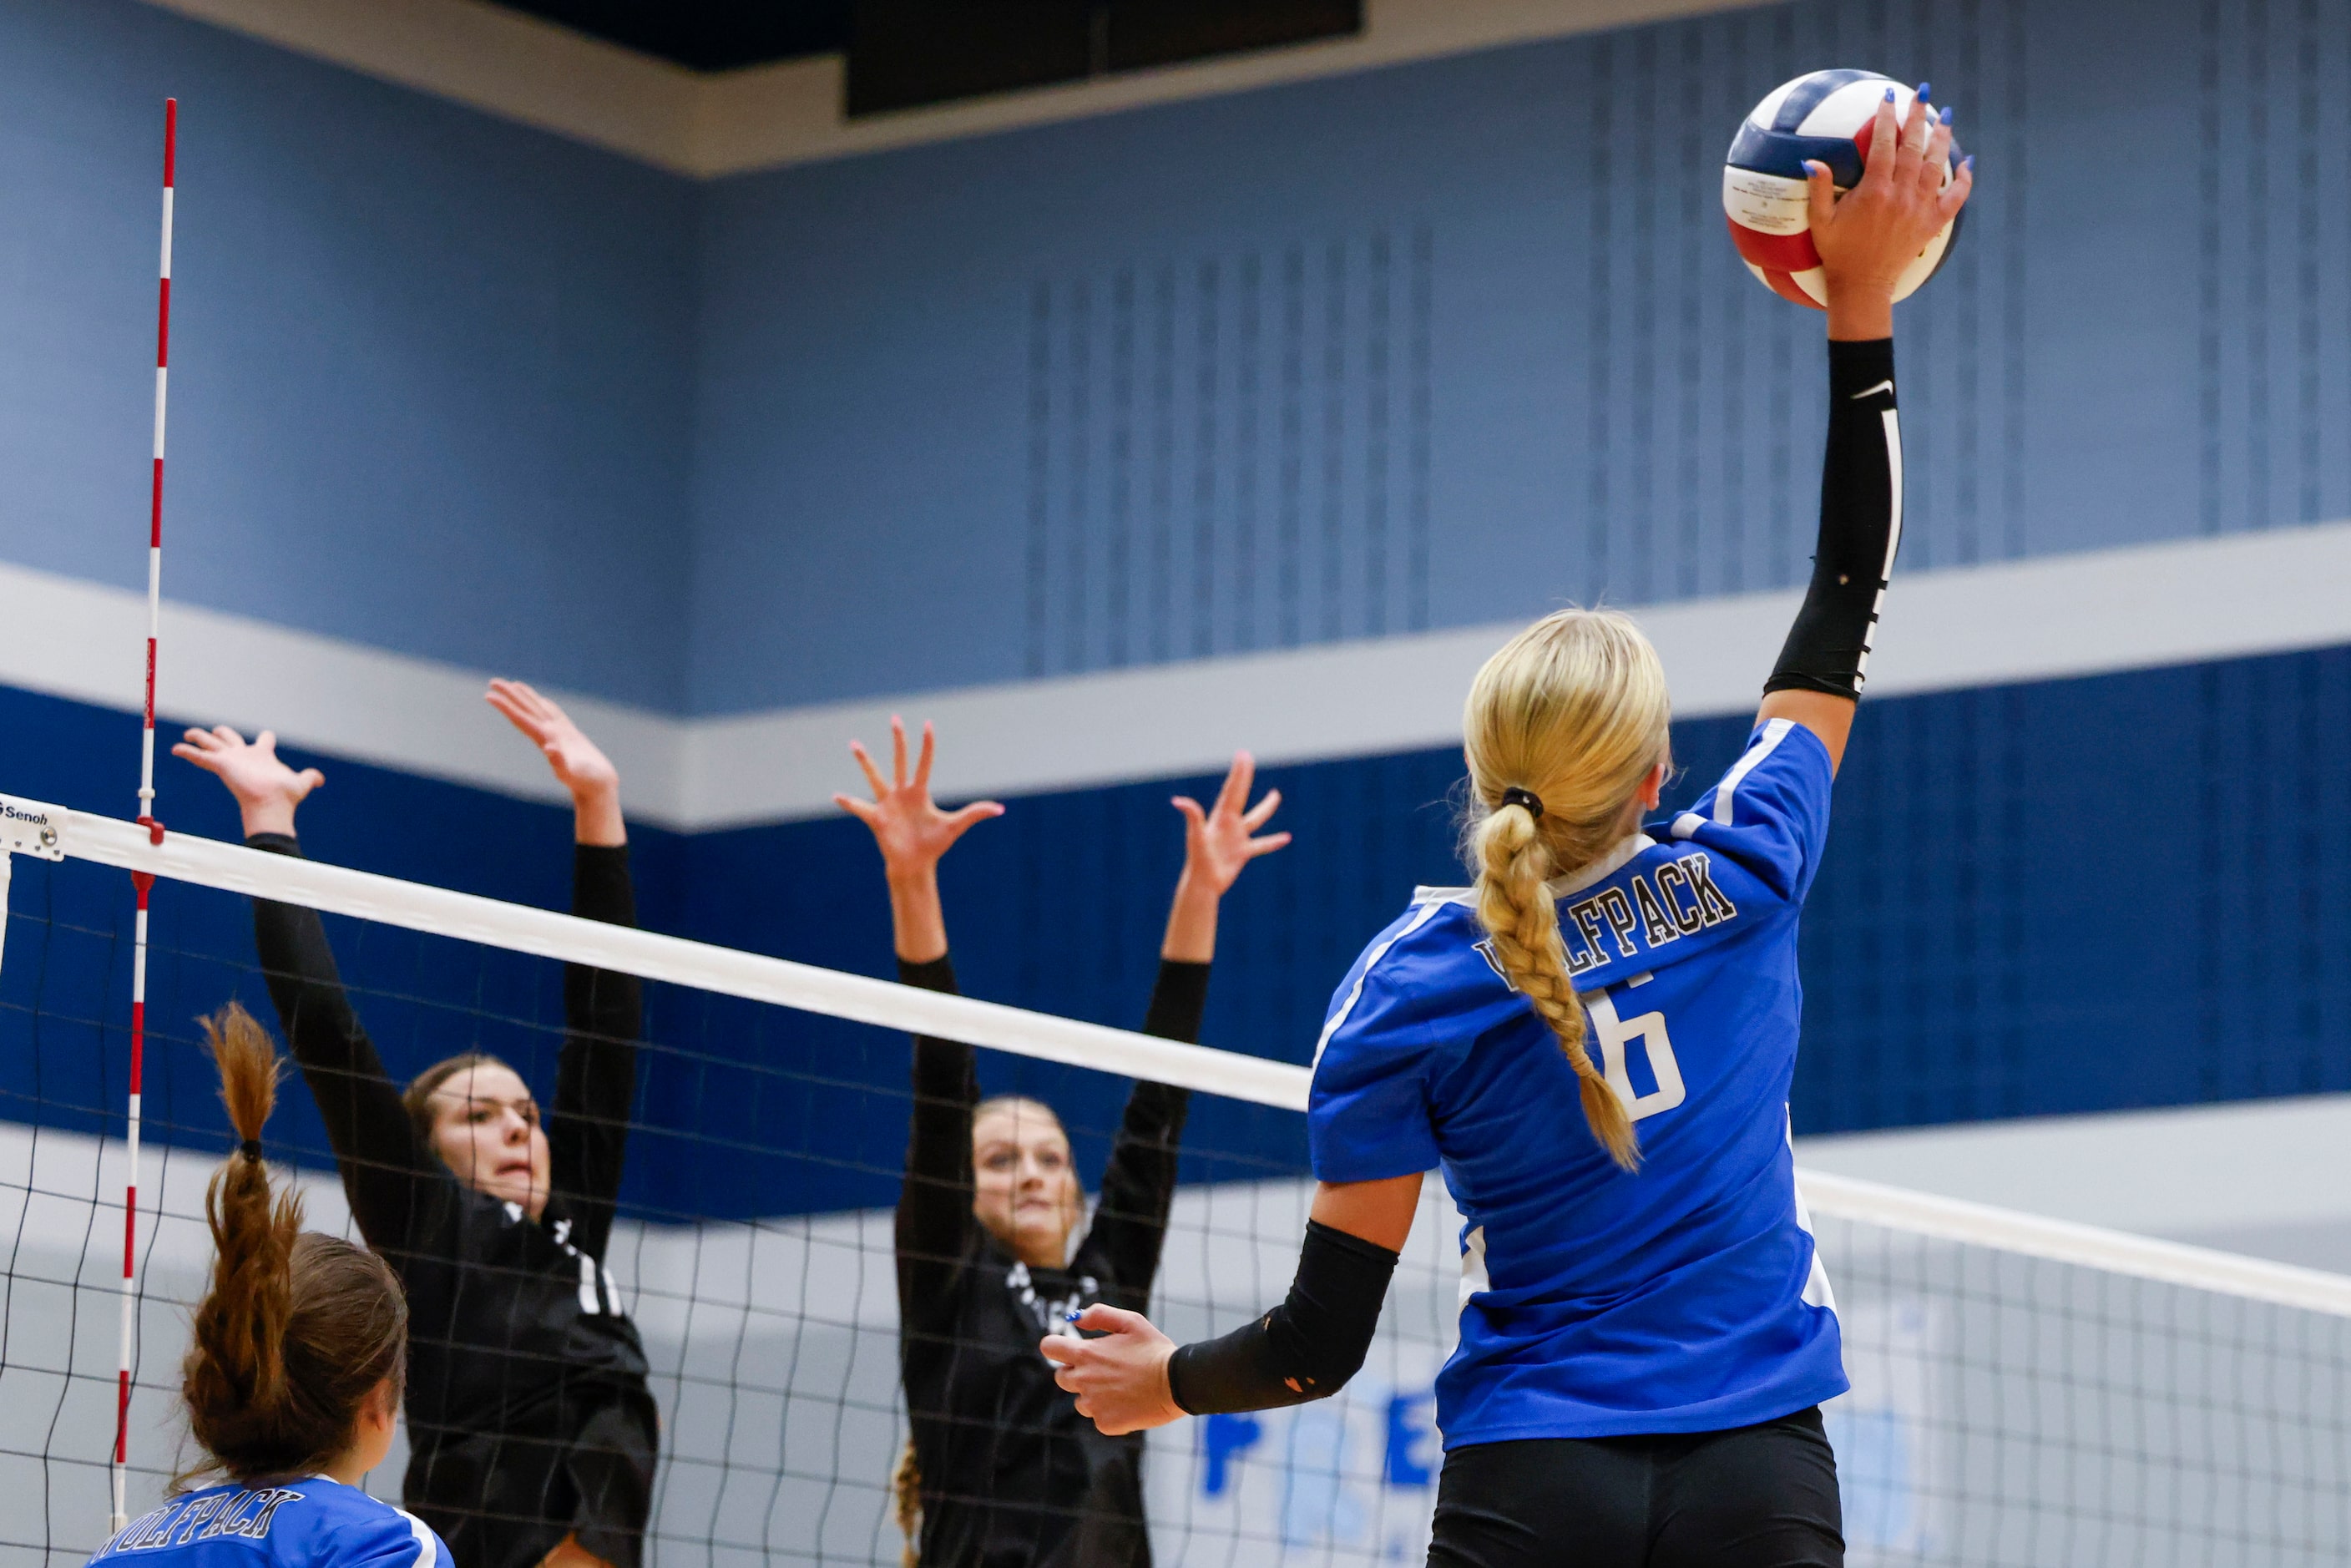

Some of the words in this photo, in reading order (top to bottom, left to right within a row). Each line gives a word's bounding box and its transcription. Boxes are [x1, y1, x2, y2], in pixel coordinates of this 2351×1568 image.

[5, 806, 48, 825] Senoh
[1471, 852, 1738, 992] LFPACK
[1581, 971, 1686, 1122] 6
[90, 1489, 306, 1565] WOLFPACK
